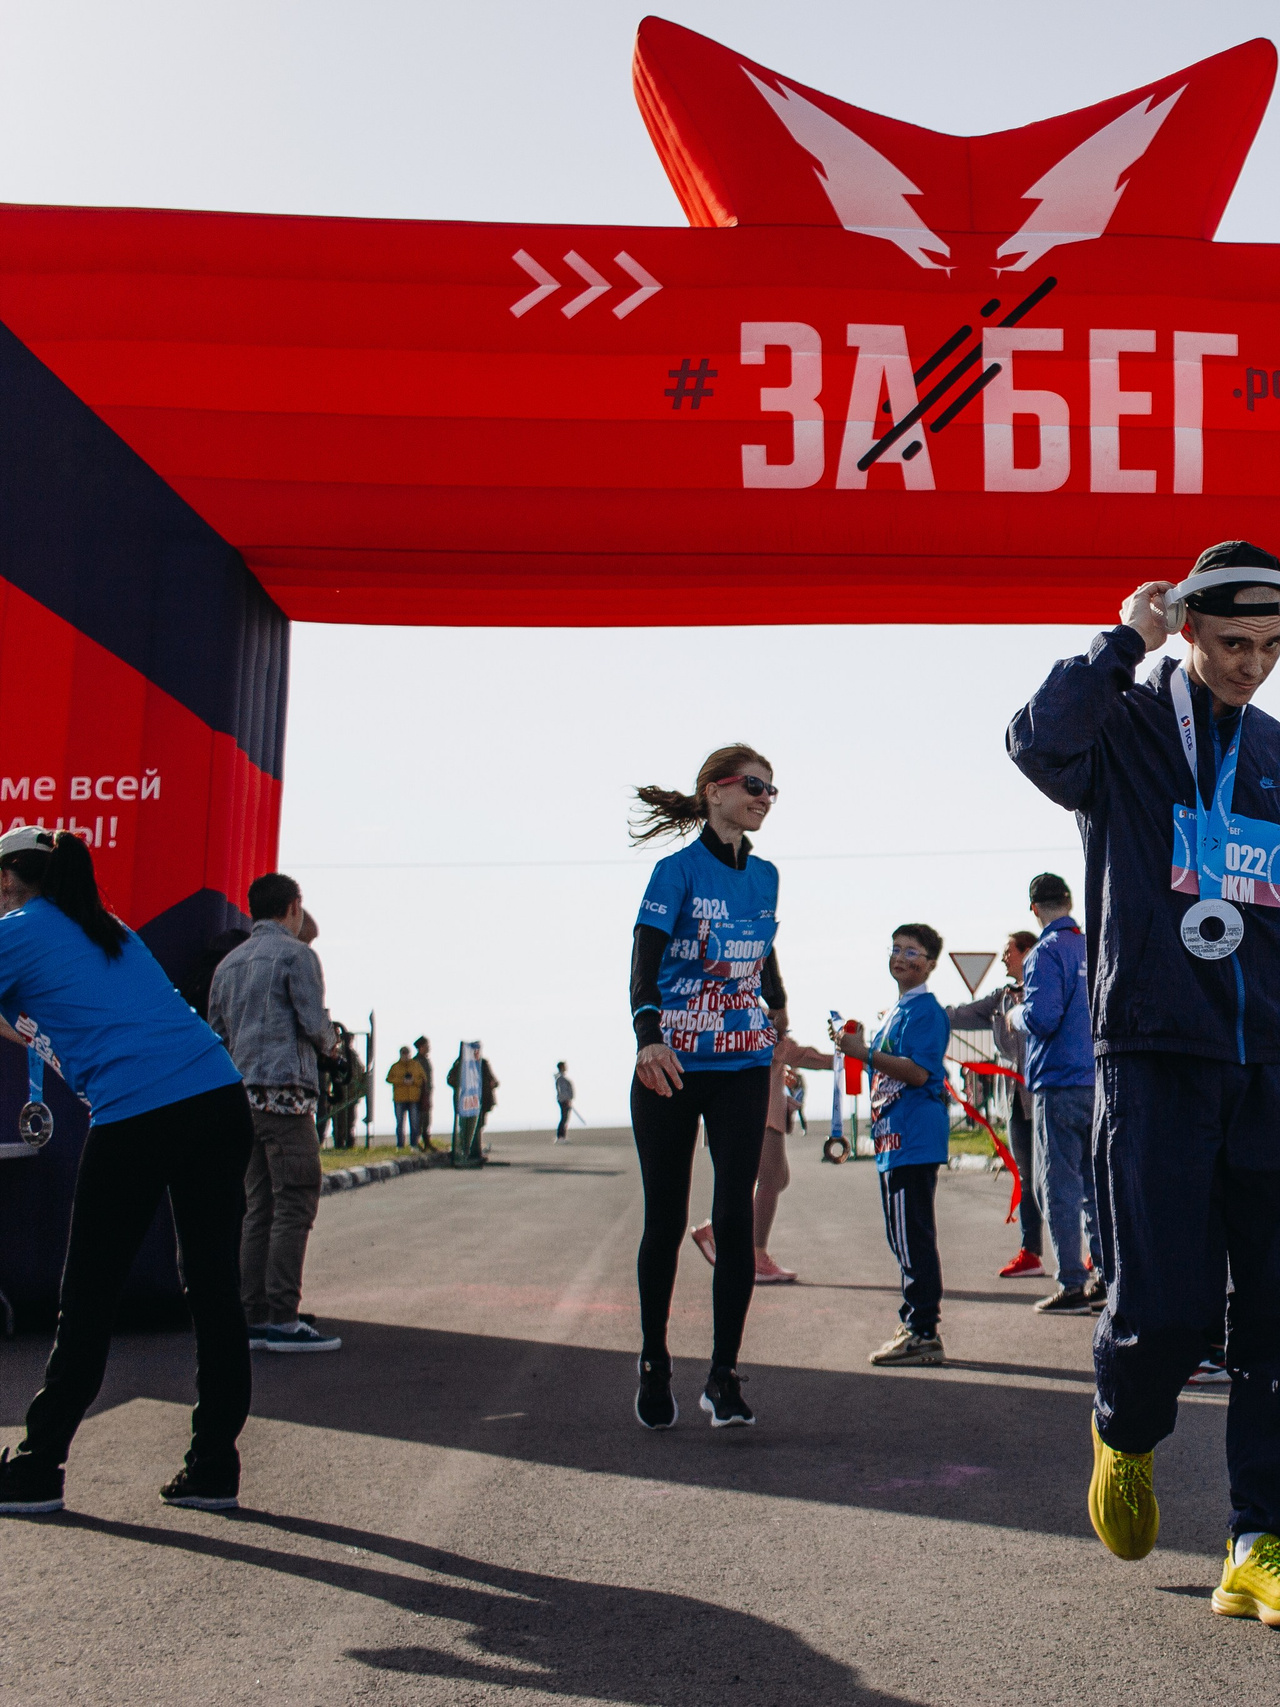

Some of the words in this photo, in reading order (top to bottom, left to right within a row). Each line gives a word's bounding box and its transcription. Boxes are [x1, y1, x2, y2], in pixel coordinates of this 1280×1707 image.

[70, 768, 161, 801] всей
[1225, 842, 1267, 877] 022
[692, 897, 730, 920] 2024
[660, 1009, 725, 1033] ЛЮБОВЬ
